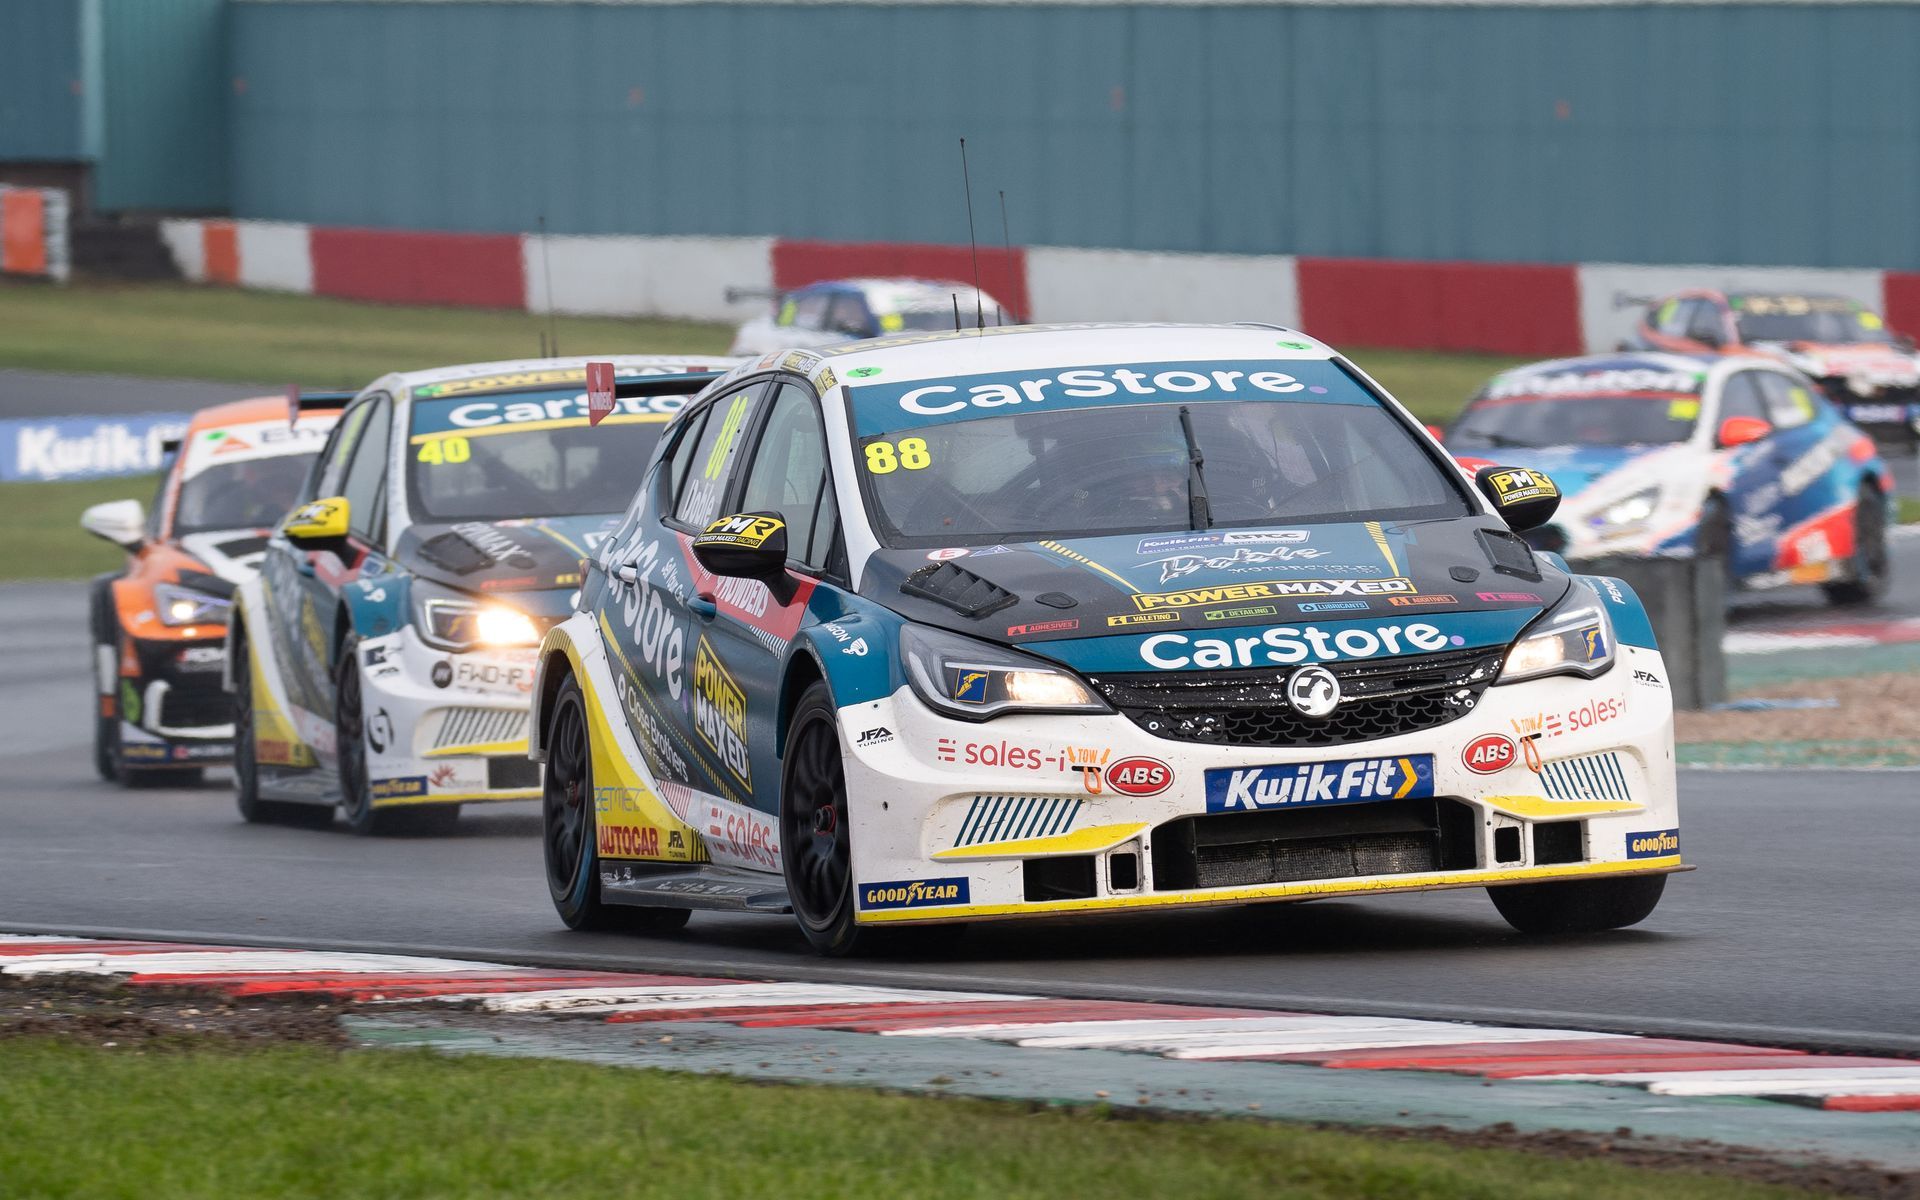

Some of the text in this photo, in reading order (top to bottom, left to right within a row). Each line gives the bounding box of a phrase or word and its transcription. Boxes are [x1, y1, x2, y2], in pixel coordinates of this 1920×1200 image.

[418, 436, 470, 465] 40
[864, 437, 931, 474] 88
[705, 517, 776, 536] PMR
[716, 535, 737, 543] MAXED
[736, 537, 761, 546] RACING
[1141, 580, 1408, 608] POWER MAXED
[1228, 607, 1269, 618] DETAILING
[1317, 602, 1366, 611] LUBRICANTS
[1029, 620, 1073, 632] ADHESIVES
[1132, 613, 1172, 623] VALETING
[1633, 670, 1661, 683] JFA
[698, 652, 746, 746] POWER
[1568, 692, 1626, 732] sales-i
[628, 686, 689, 783] Close Brothers
[697, 688, 749, 780] MAXED
[857, 726, 893, 743] JFA
[857, 737, 895, 748] TUNING
[966, 740, 1065, 772] sales-i
[1078, 748, 1098, 763] TOW
[1470, 745, 1510, 765] ABS
[1116, 767, 1165, 785] ABS
[600, 826, 660, 856] AUTOCAR
[668, 830, 685, 849] JFA
[1632, 833, 1679, 855] GOODYEAR
[867, 881, 959, 905] GOODYEAR
